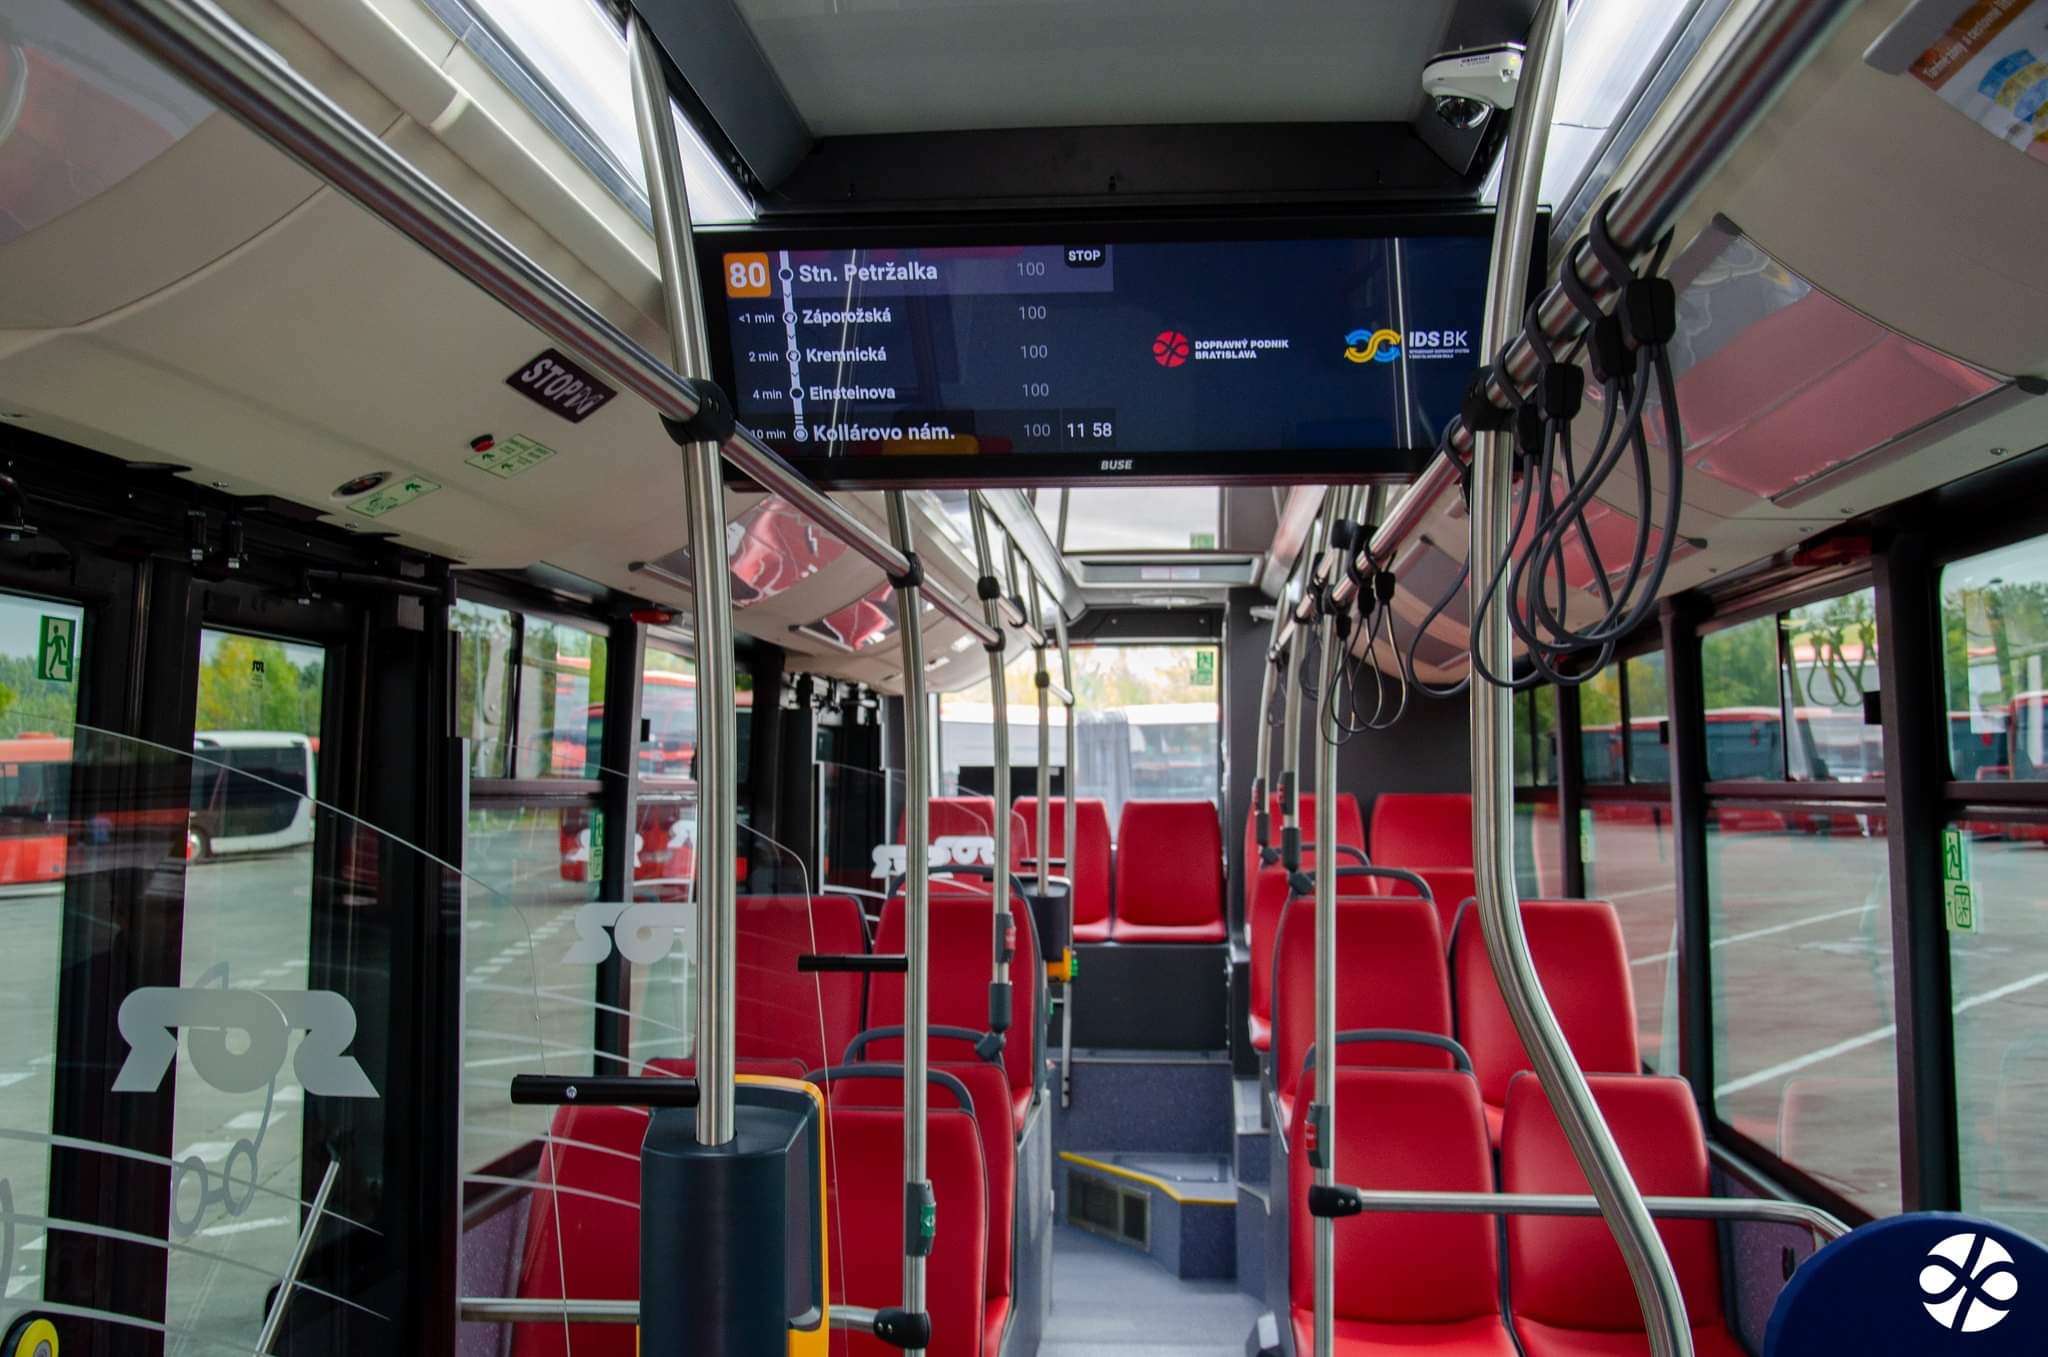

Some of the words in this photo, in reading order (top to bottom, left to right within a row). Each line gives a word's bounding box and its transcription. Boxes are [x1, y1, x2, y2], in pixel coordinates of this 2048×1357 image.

[1068, 249, 1101, 262] STOP
[729, 261, 767, 288] 80
[799, 264, 838, 282] Stn.
[844, 261, 939, 282] Petržalka
[1017, 261, 1045, 276] 100
[754, 312, 775, 323] min
[802, 307, 892, 327] Záporožská
[1018, 305, 1047, 320] 100
[1195, 338, 1249, 350] DOPRAVNÝ
[1250, 339, 1289, 349] PODNIK
[1408, 330, 1440, 347] IDS
[1443, 330, 1468, 347] BK
[748, 352, 756, 362] 2
[758, 350, 778, 362] min
[806, 346, 887, 363] Kremnická
[1020, 344, 1048, 359] 100
[1195, 350, 1257, 360] BRATISLAVA
[521, 358, 584, 401] STOP
[752, 389, 760, 399] 4
[762, 388, 782, 399] min
[809, 385, 896, 401] Einsteinova
[1022, 383, 1049, 397] 100
[766, 429, 786, 440] min
[813, 424, 903, 441] Kollárovo
[908, 422, 956, 440] nám.
[1023, 423, 1051, 437] 100
[1100, 459, 1133, 471] BUSE
